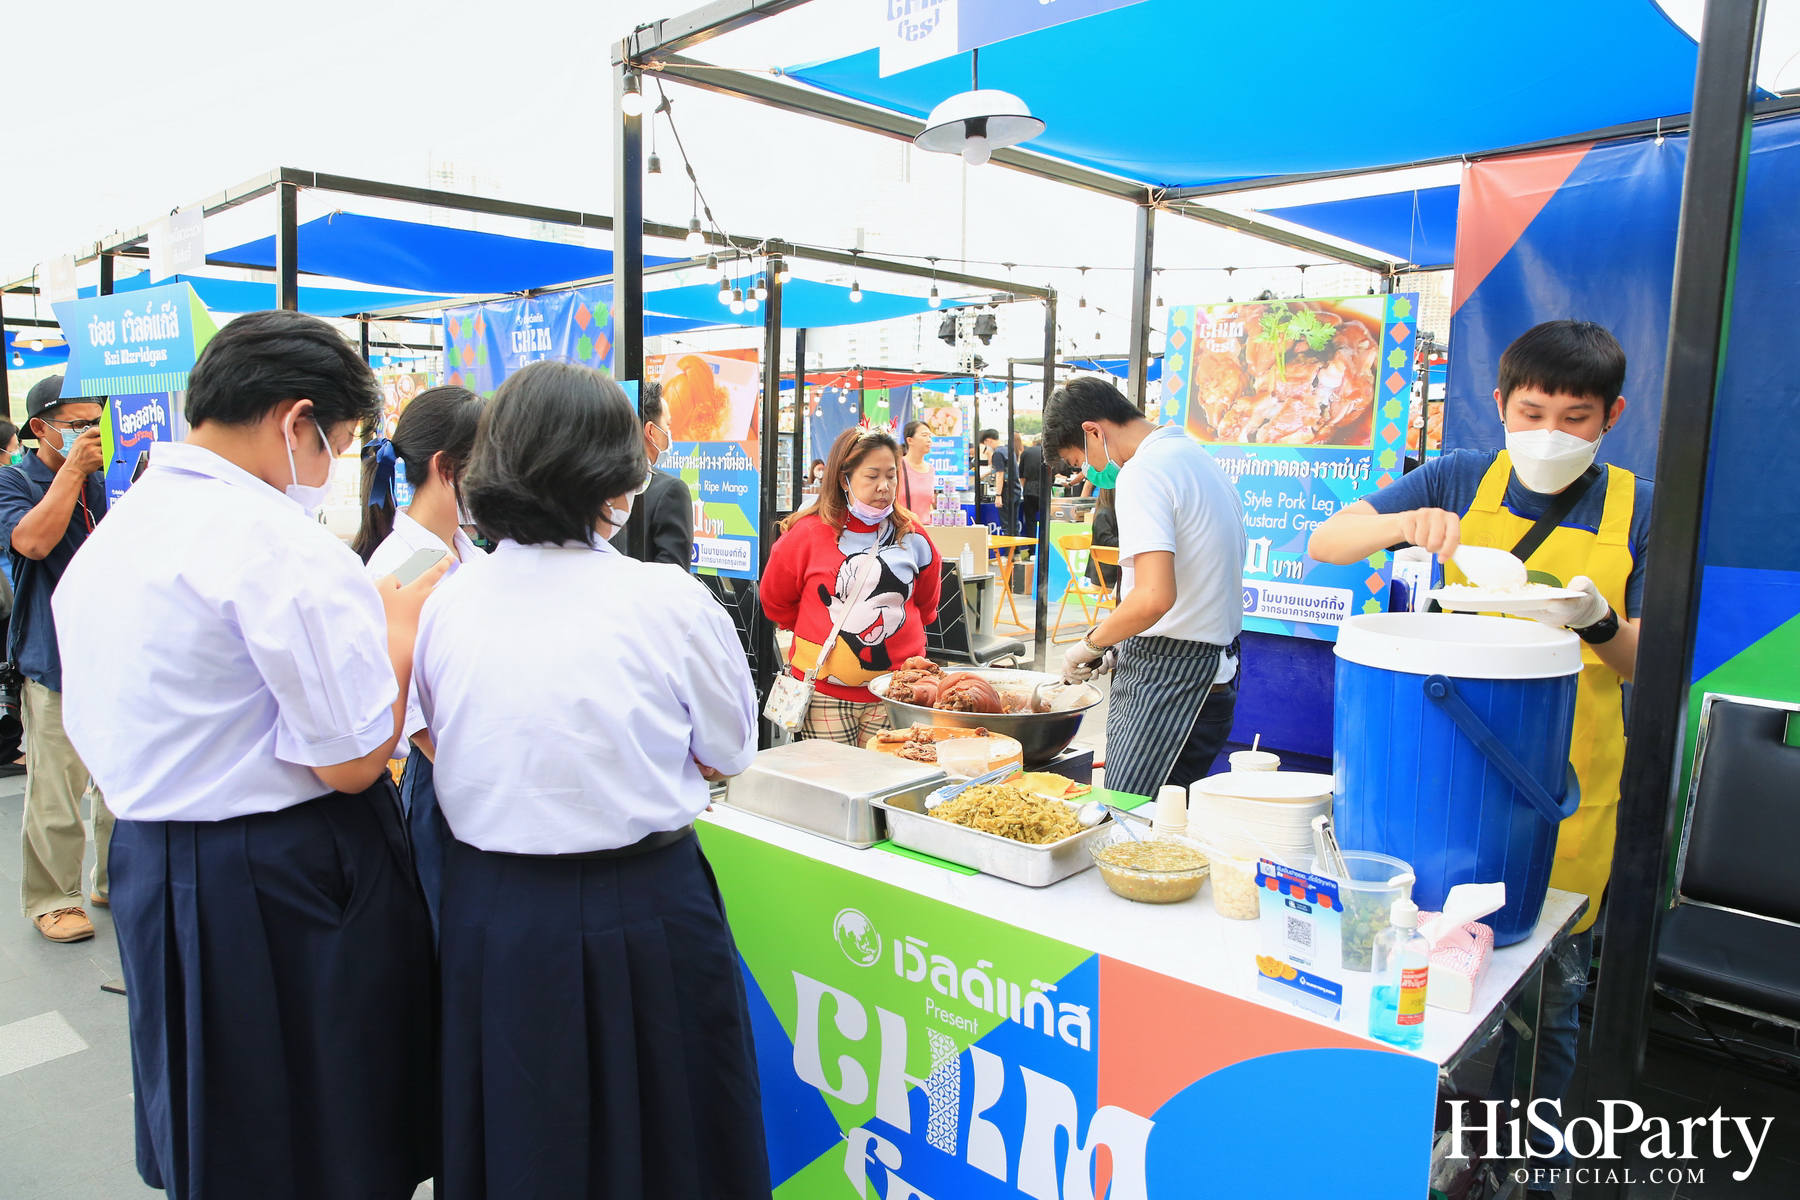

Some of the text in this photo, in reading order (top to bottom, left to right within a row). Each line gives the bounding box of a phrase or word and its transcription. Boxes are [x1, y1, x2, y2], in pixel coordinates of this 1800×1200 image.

[703, 479, 720, 495] Ripe
[721, 481, 749, 496] Mango
[1243, 489, 1273, 511] Style
[1277, 492, 1306, 510] Pork
[1311, 494, 1334, 517] Leg
[1272, 559, 1304, 580] บาท
[1262, 589, 1346, 611] โมบายแบงก์กิ้ง
[1261, 604, 1344, 622] จากธนาคารกรุงเทพ
[893, 935, 1092, 1051] เวิลด์แก๊ส
[925, 996, 979, 1036] Present
